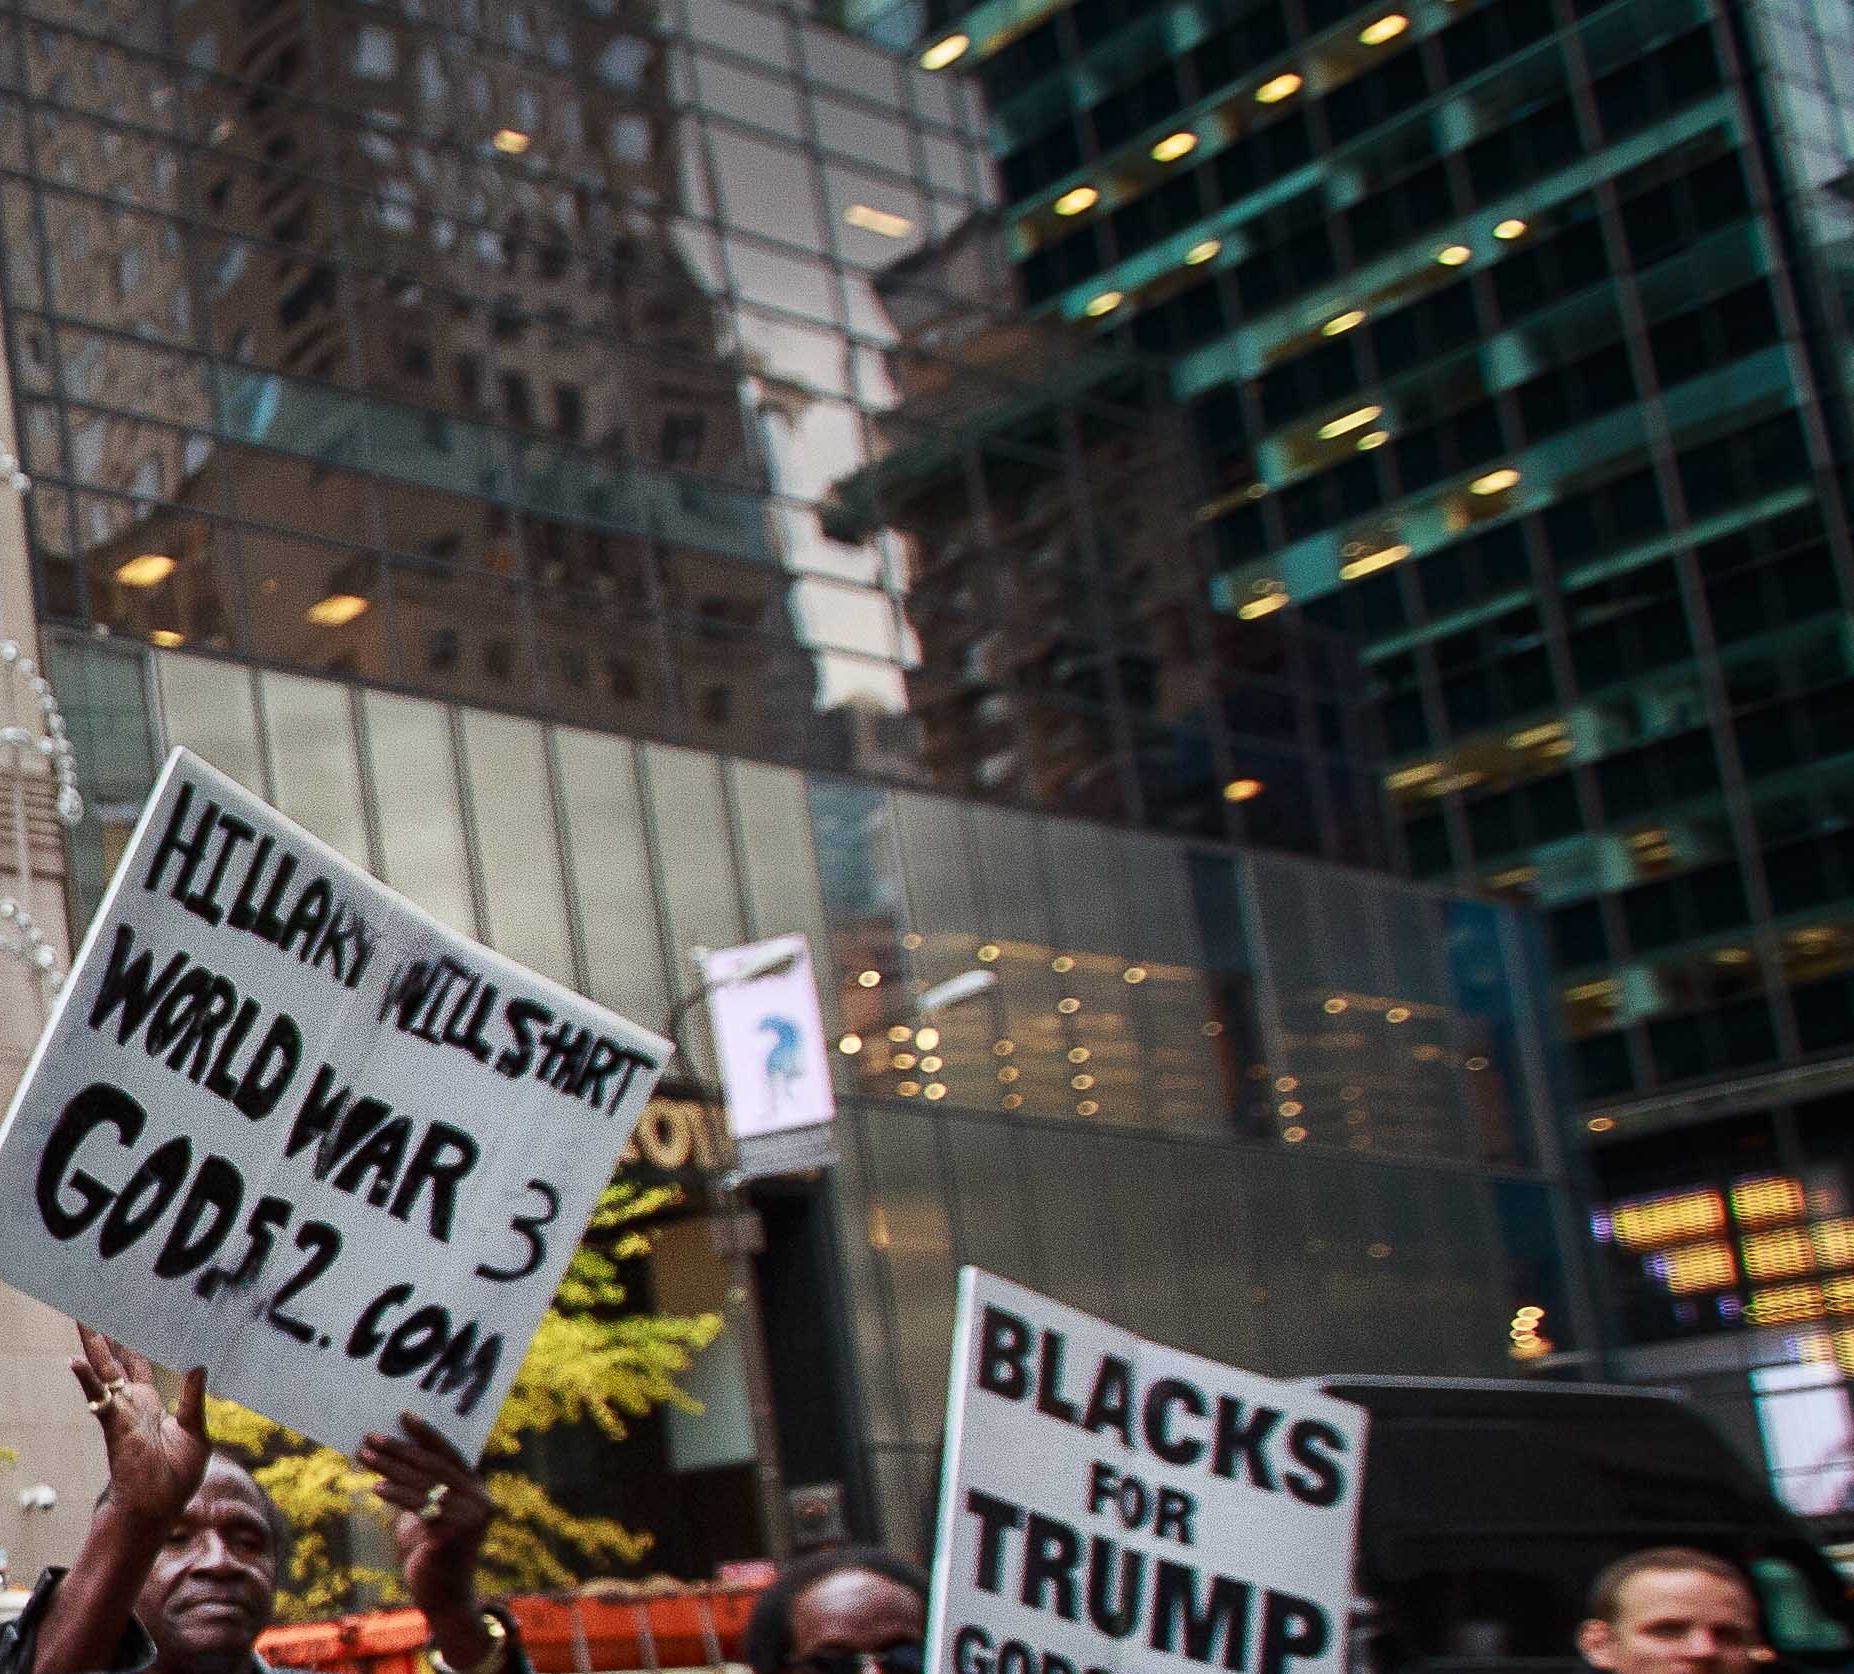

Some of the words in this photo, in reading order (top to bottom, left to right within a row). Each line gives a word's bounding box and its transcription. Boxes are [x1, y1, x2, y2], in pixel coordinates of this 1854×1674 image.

[90, 923, 303, 1120] WORLD
[285, 1062, 479, 1243] WAR
[476, 1179, 562, 1283] 3
[375, 956, 497, 1063] WILL
[495, 996, 659, 1117] START
[36, 1081, 503, 1415] GODS2.COM
[978, 1305, 1348, 1508] BLACKS
[1089, 1461, 1198, 1545] FOR
